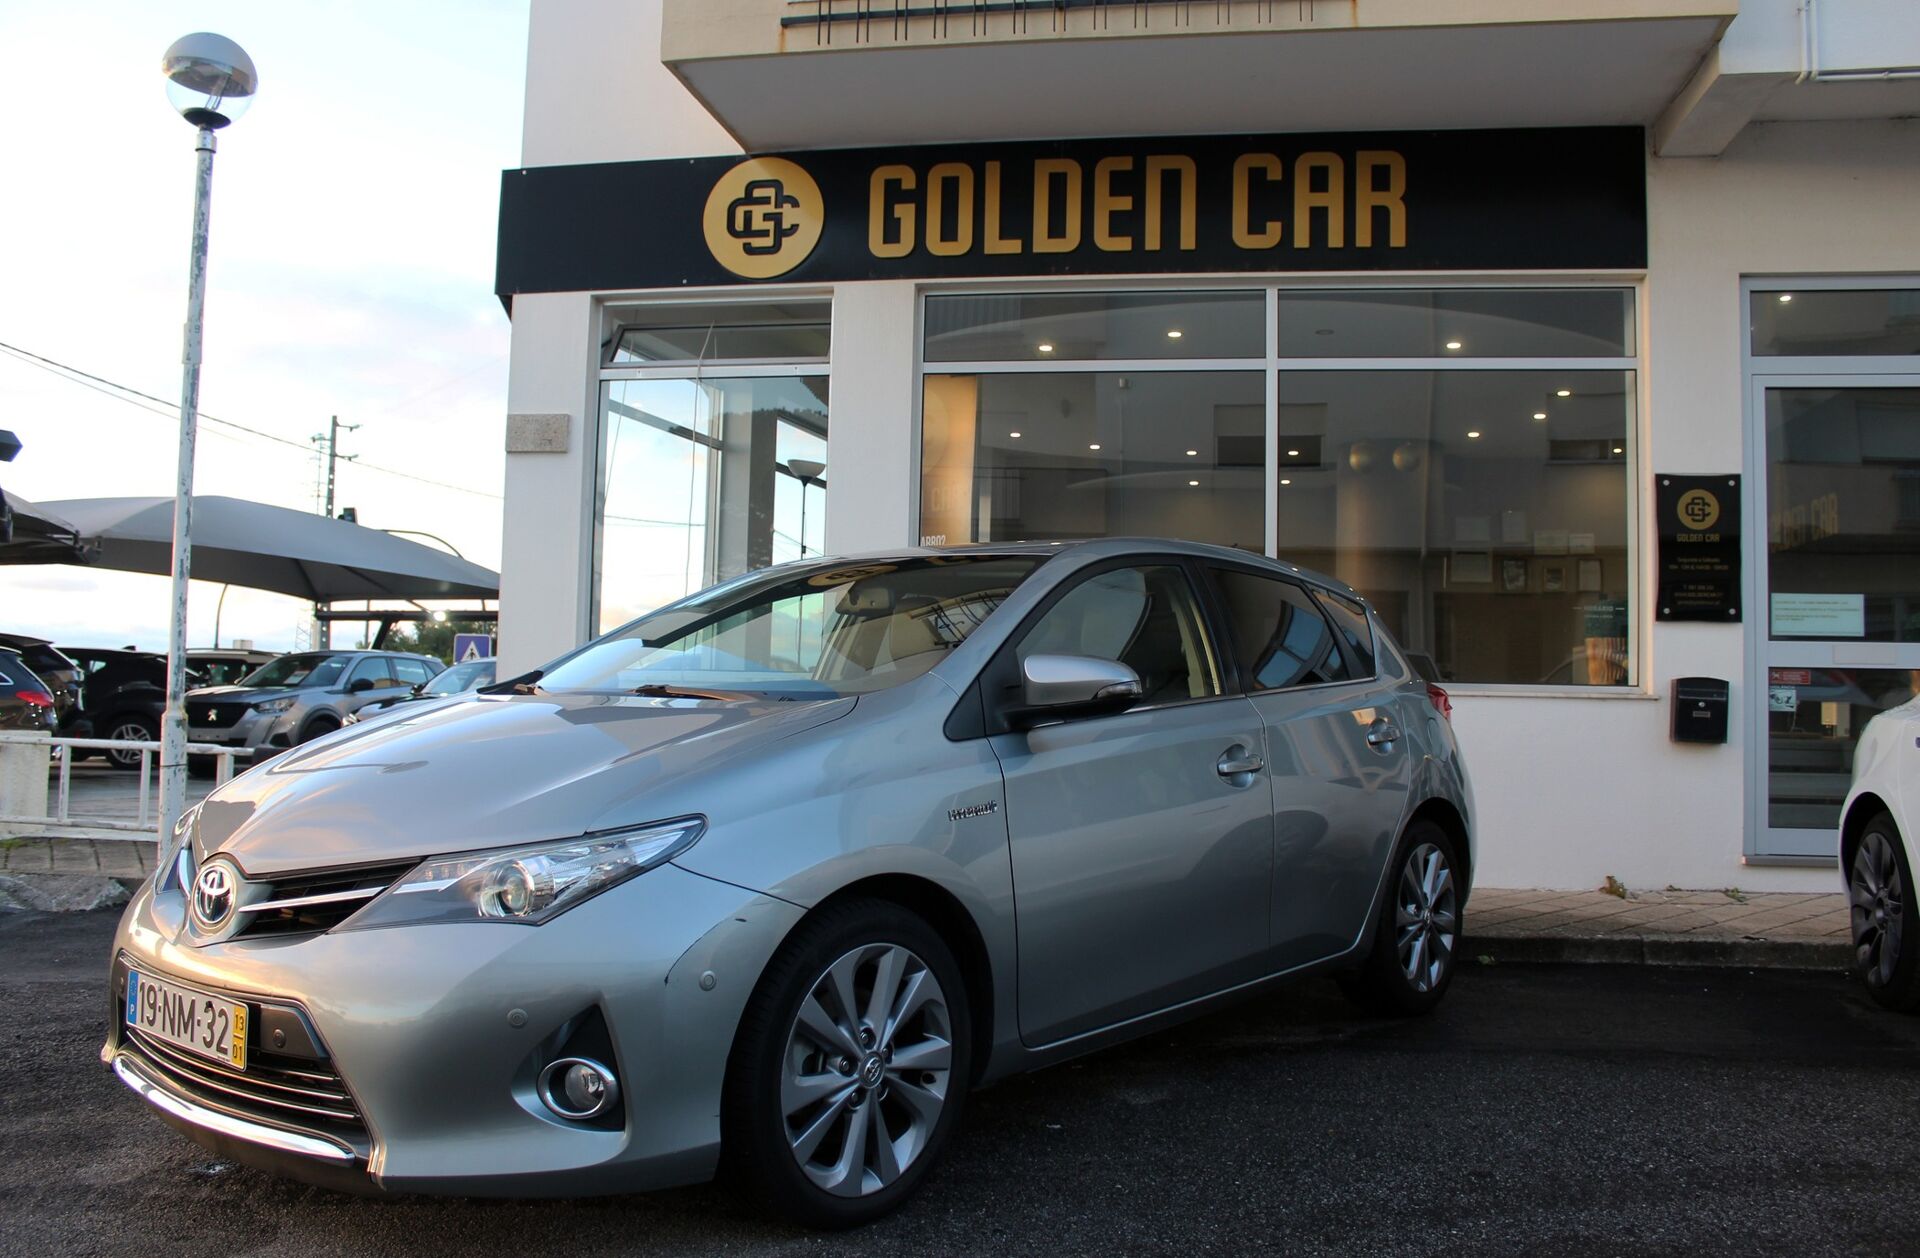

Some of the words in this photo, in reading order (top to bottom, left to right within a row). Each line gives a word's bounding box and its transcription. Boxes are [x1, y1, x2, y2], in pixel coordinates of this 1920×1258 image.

[868, 154, 1197, 259] GOLDEN
[1231, 149, 1407, 250] CAR
[1676, 533, 1703, 543] GOLDEN
[1705, 533, 1720, 543] CAR
[129, 1003, 135, 1015] P
